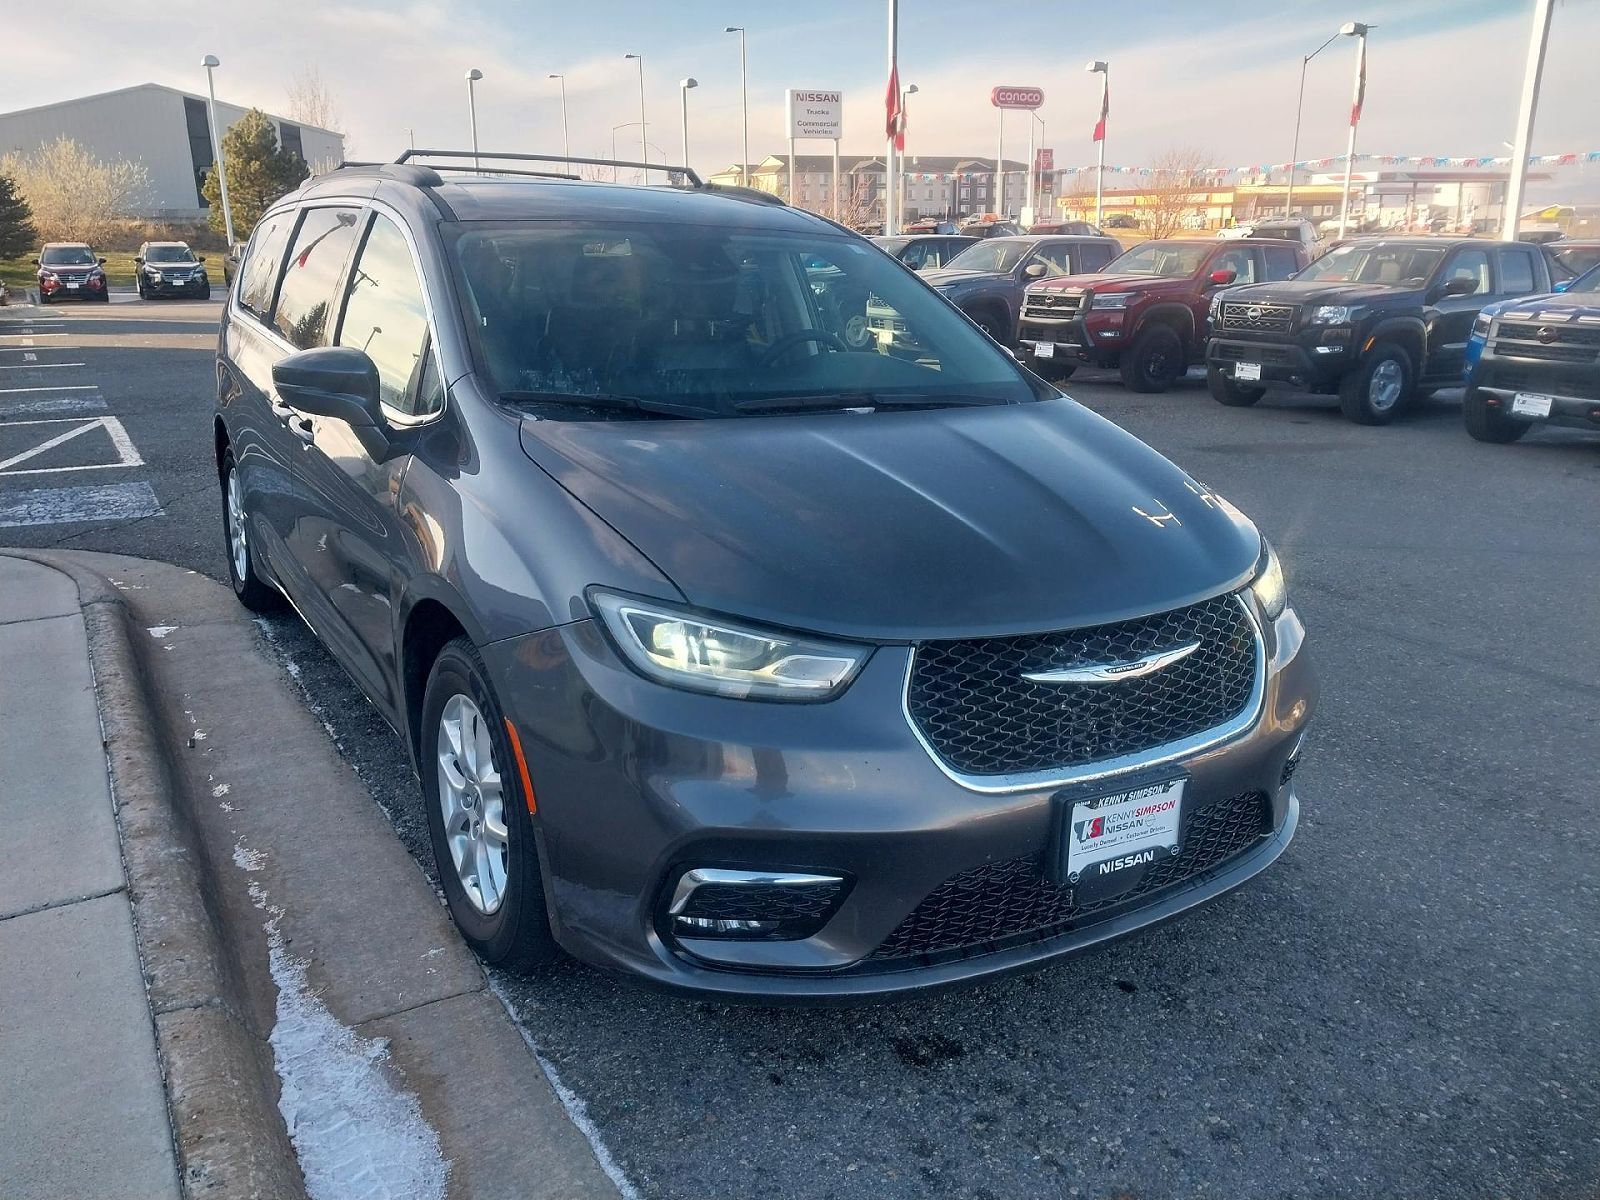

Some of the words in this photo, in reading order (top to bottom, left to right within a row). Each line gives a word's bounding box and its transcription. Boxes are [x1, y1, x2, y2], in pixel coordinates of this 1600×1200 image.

[796, 93, 839, 102] NISSAN
[1098, 793, 1128, 808] KENNY
[1127, 784, 1165, 801] SIMPSON
[1105, 819, 1144, 834] NISSAN
[1099, 850, 1154, 875] NISSAN
